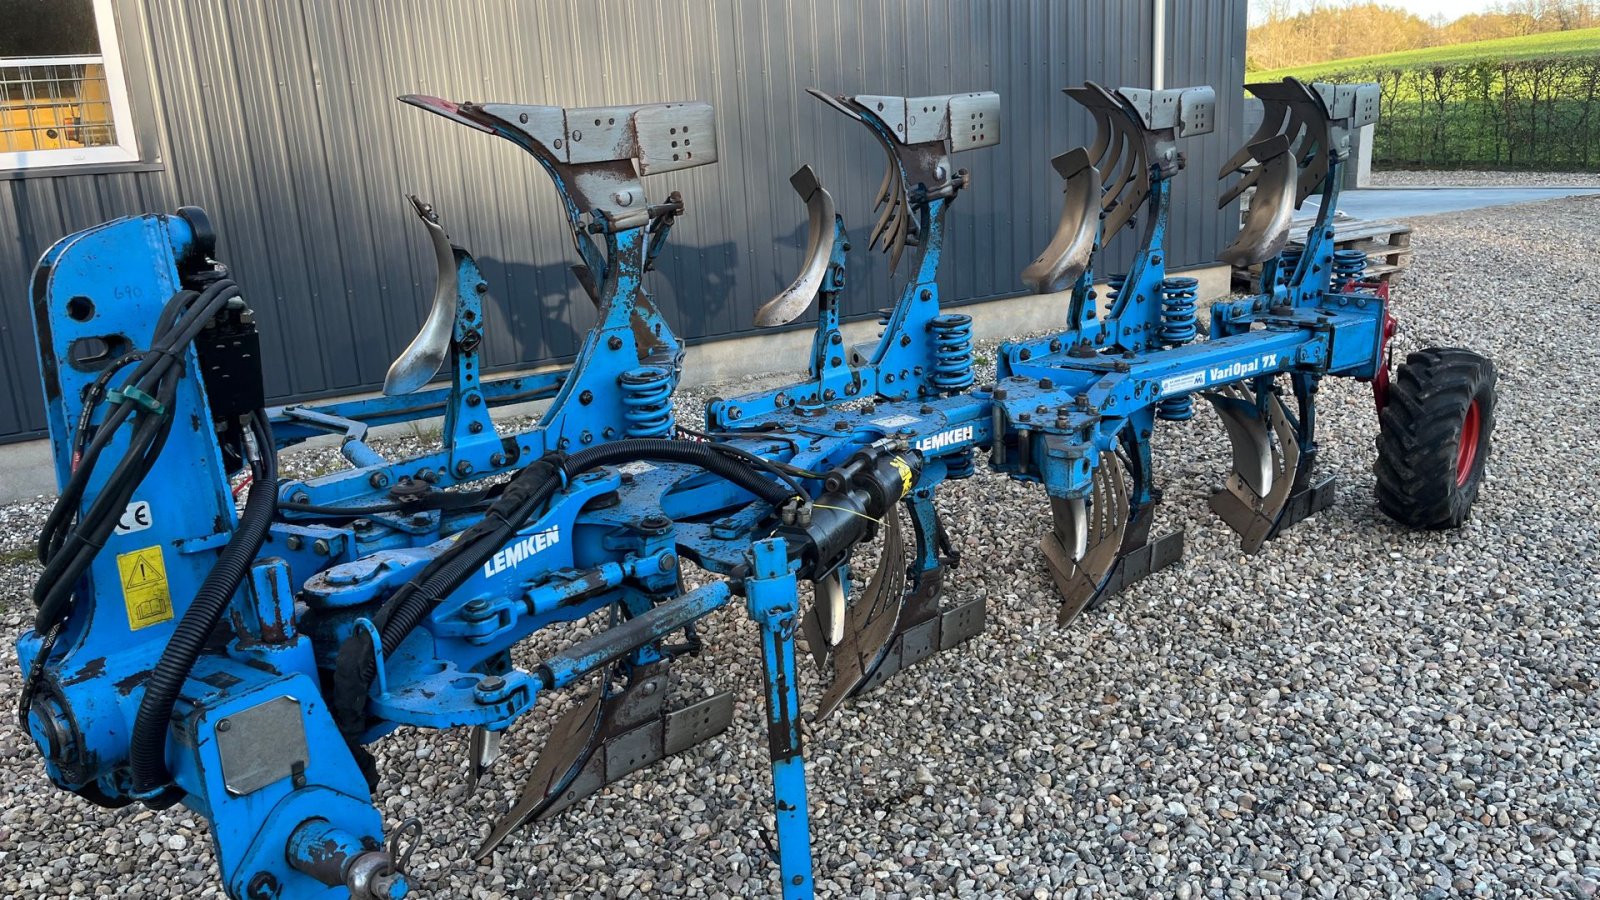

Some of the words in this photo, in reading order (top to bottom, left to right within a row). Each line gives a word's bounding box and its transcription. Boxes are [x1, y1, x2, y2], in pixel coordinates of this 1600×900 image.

[1210, 358, 1259, 381] VariOpal
[1262, 354, 1277, 368] 7X
[484, 524, 560, 579] LEMKEN
